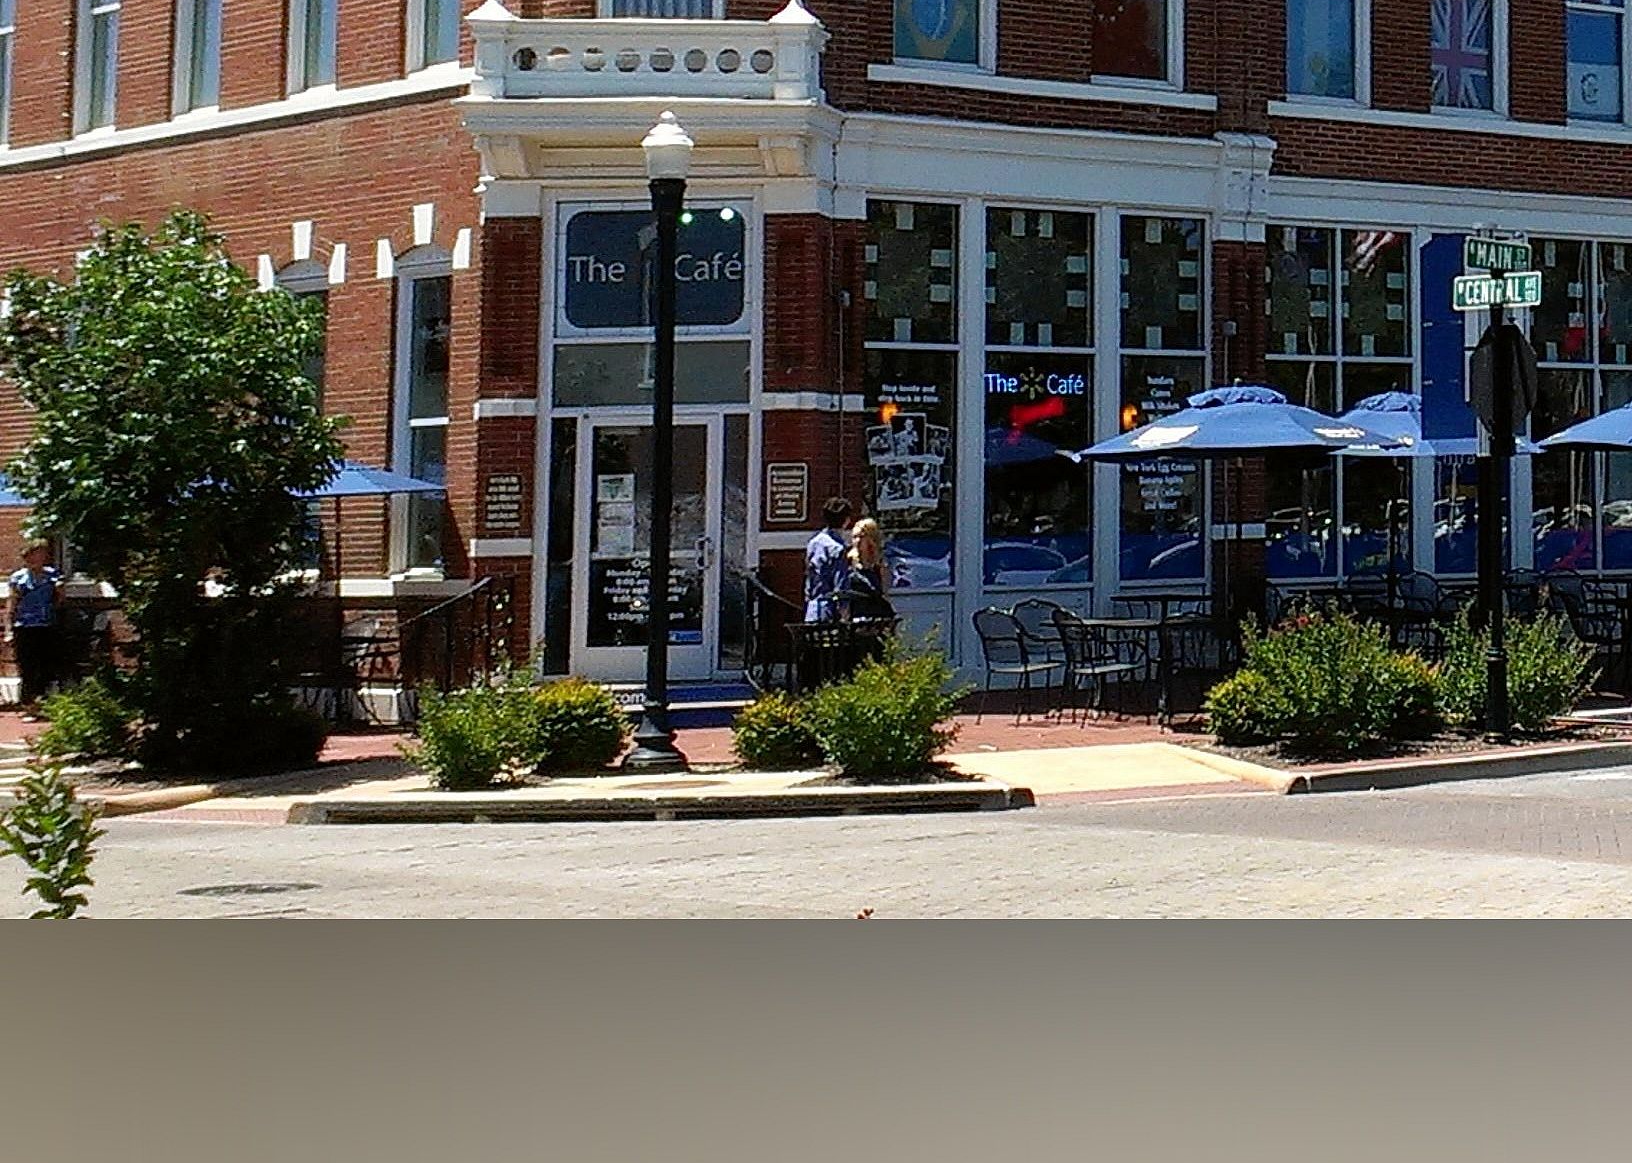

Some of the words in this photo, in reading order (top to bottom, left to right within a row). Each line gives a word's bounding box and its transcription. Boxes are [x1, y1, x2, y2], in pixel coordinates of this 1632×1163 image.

[568, 254, 626, 283] The
[674, 252, 742, 281] Café
[1476, 241, 1513, 270] MAIN
[1465, 278, 1521, 304] CENTRAL
[983, 373, 1018, 394] The
[1046, 373, 1084, 395] Café
